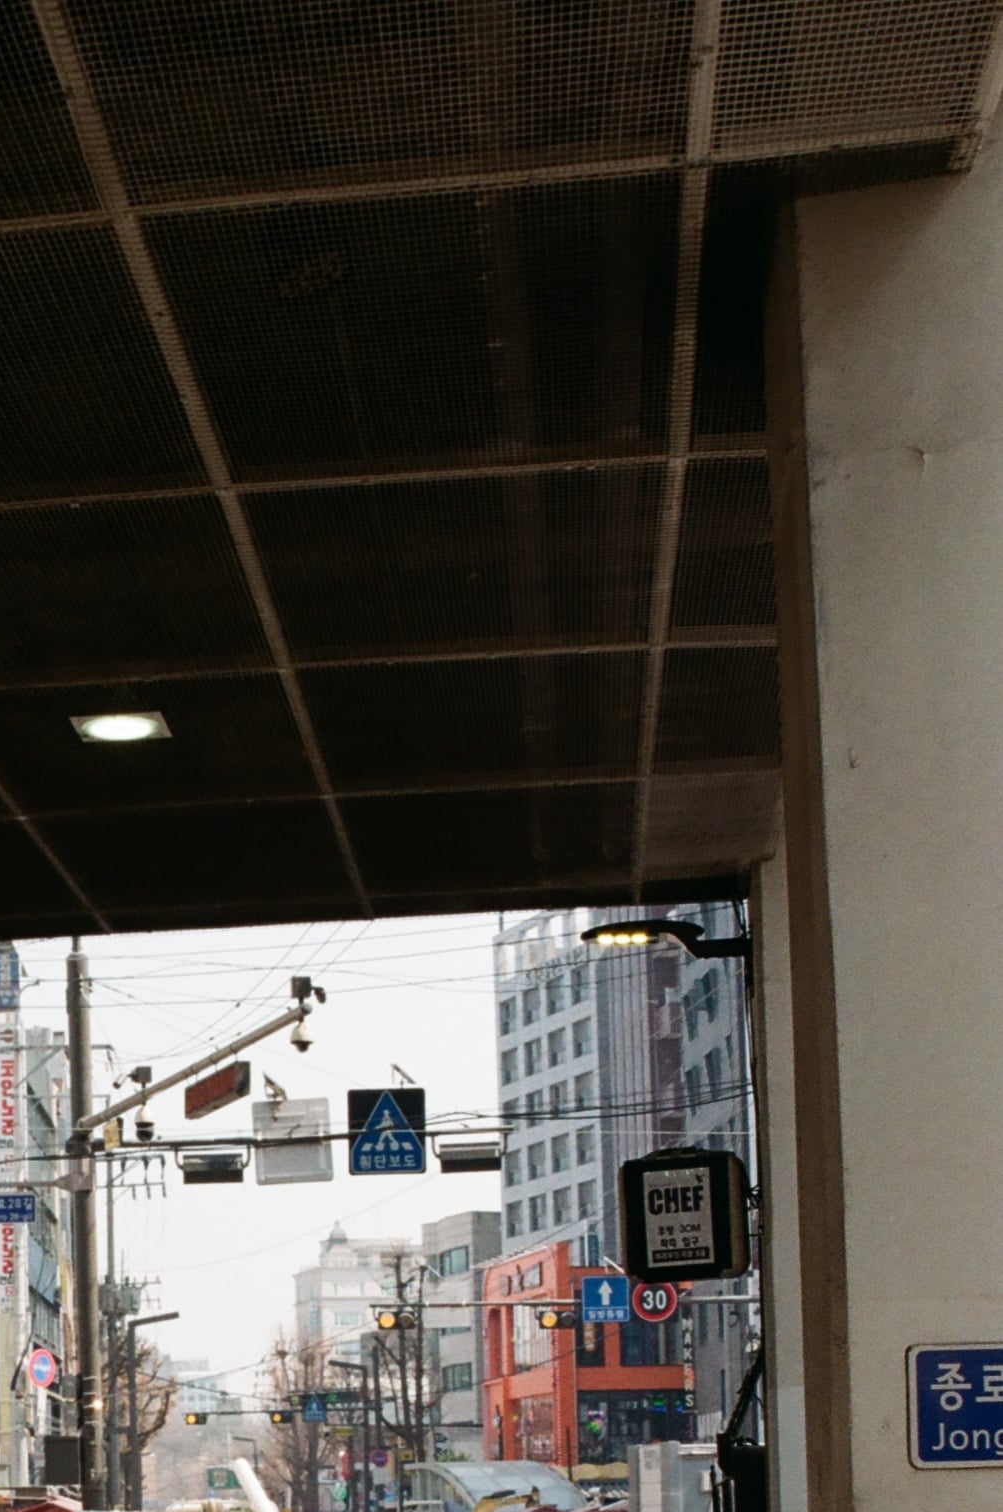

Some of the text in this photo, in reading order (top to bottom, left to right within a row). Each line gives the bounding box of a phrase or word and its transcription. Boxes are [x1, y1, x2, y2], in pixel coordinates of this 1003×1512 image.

[359, 1153, 417, 1169] 횡단보도
[647, 1185, 703, 1215] CHEF
[642, 1289, 667, 1310] 30
[681, 1318, 695, 1407] MAKERS
